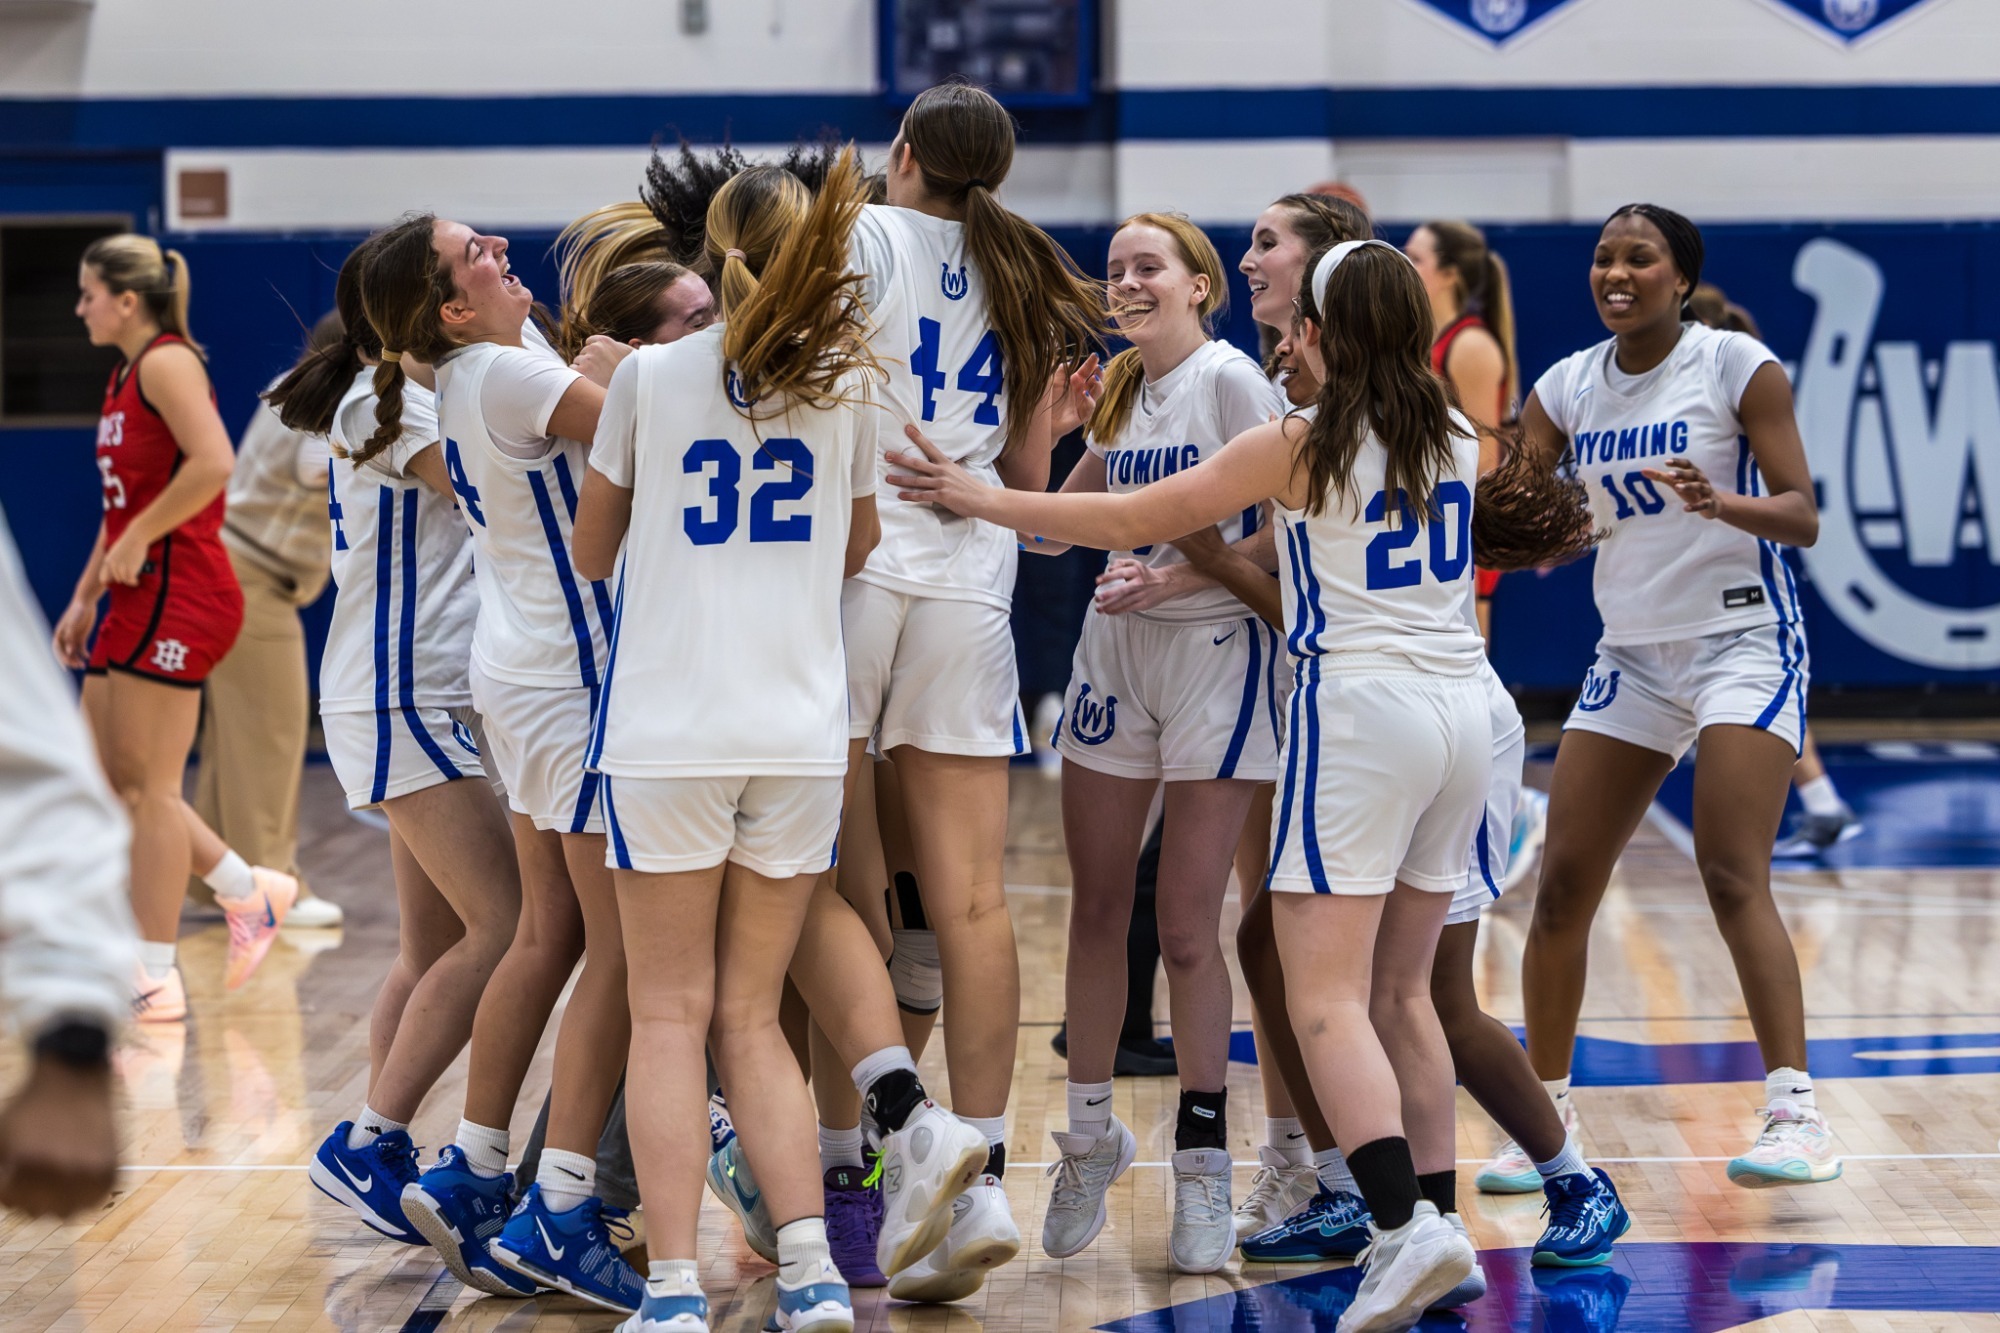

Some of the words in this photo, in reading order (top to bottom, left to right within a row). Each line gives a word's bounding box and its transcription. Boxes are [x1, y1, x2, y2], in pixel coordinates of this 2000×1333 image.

[910, 316, 1004, 426] 44
[682, 438, 814, 546] 32
[1365, 480, 1471, 590] 20
[1601, 471, 1666, 520] 10
[1081, 698, 1105, 733] W
